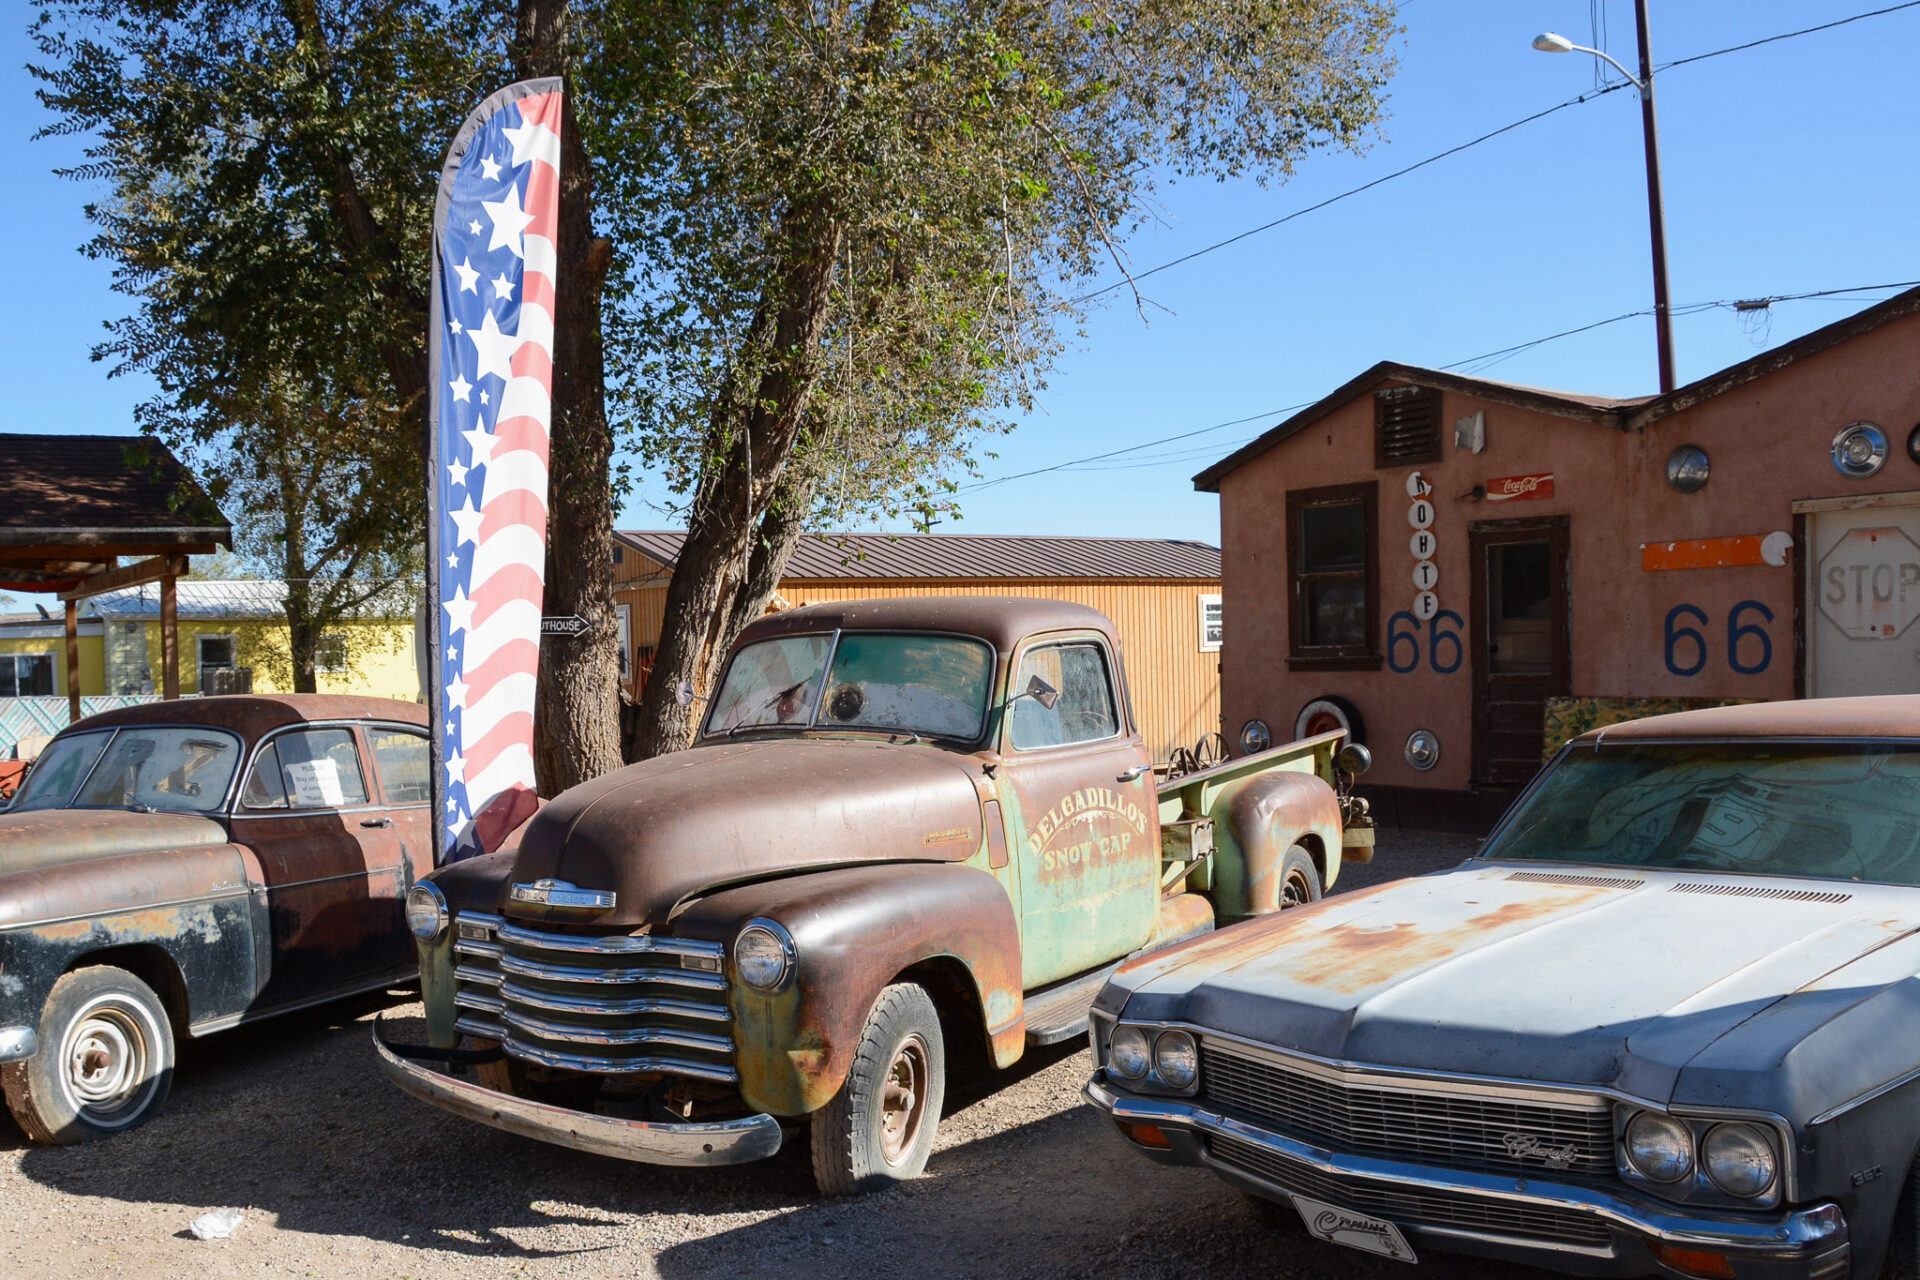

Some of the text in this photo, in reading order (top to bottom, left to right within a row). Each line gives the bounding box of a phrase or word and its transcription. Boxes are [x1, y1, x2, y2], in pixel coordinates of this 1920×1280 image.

[1826, 563, 1920, 605] STOP
[541, 619, 581, 632] UTHOUSE
[1388, 609, 1464, 674] 66
[1664, 600, 1775, 677] 66
[1028, 787, 1148, 857] DELGADILLO'S
[1044, 832, 1132, 871] SNOW CAP
